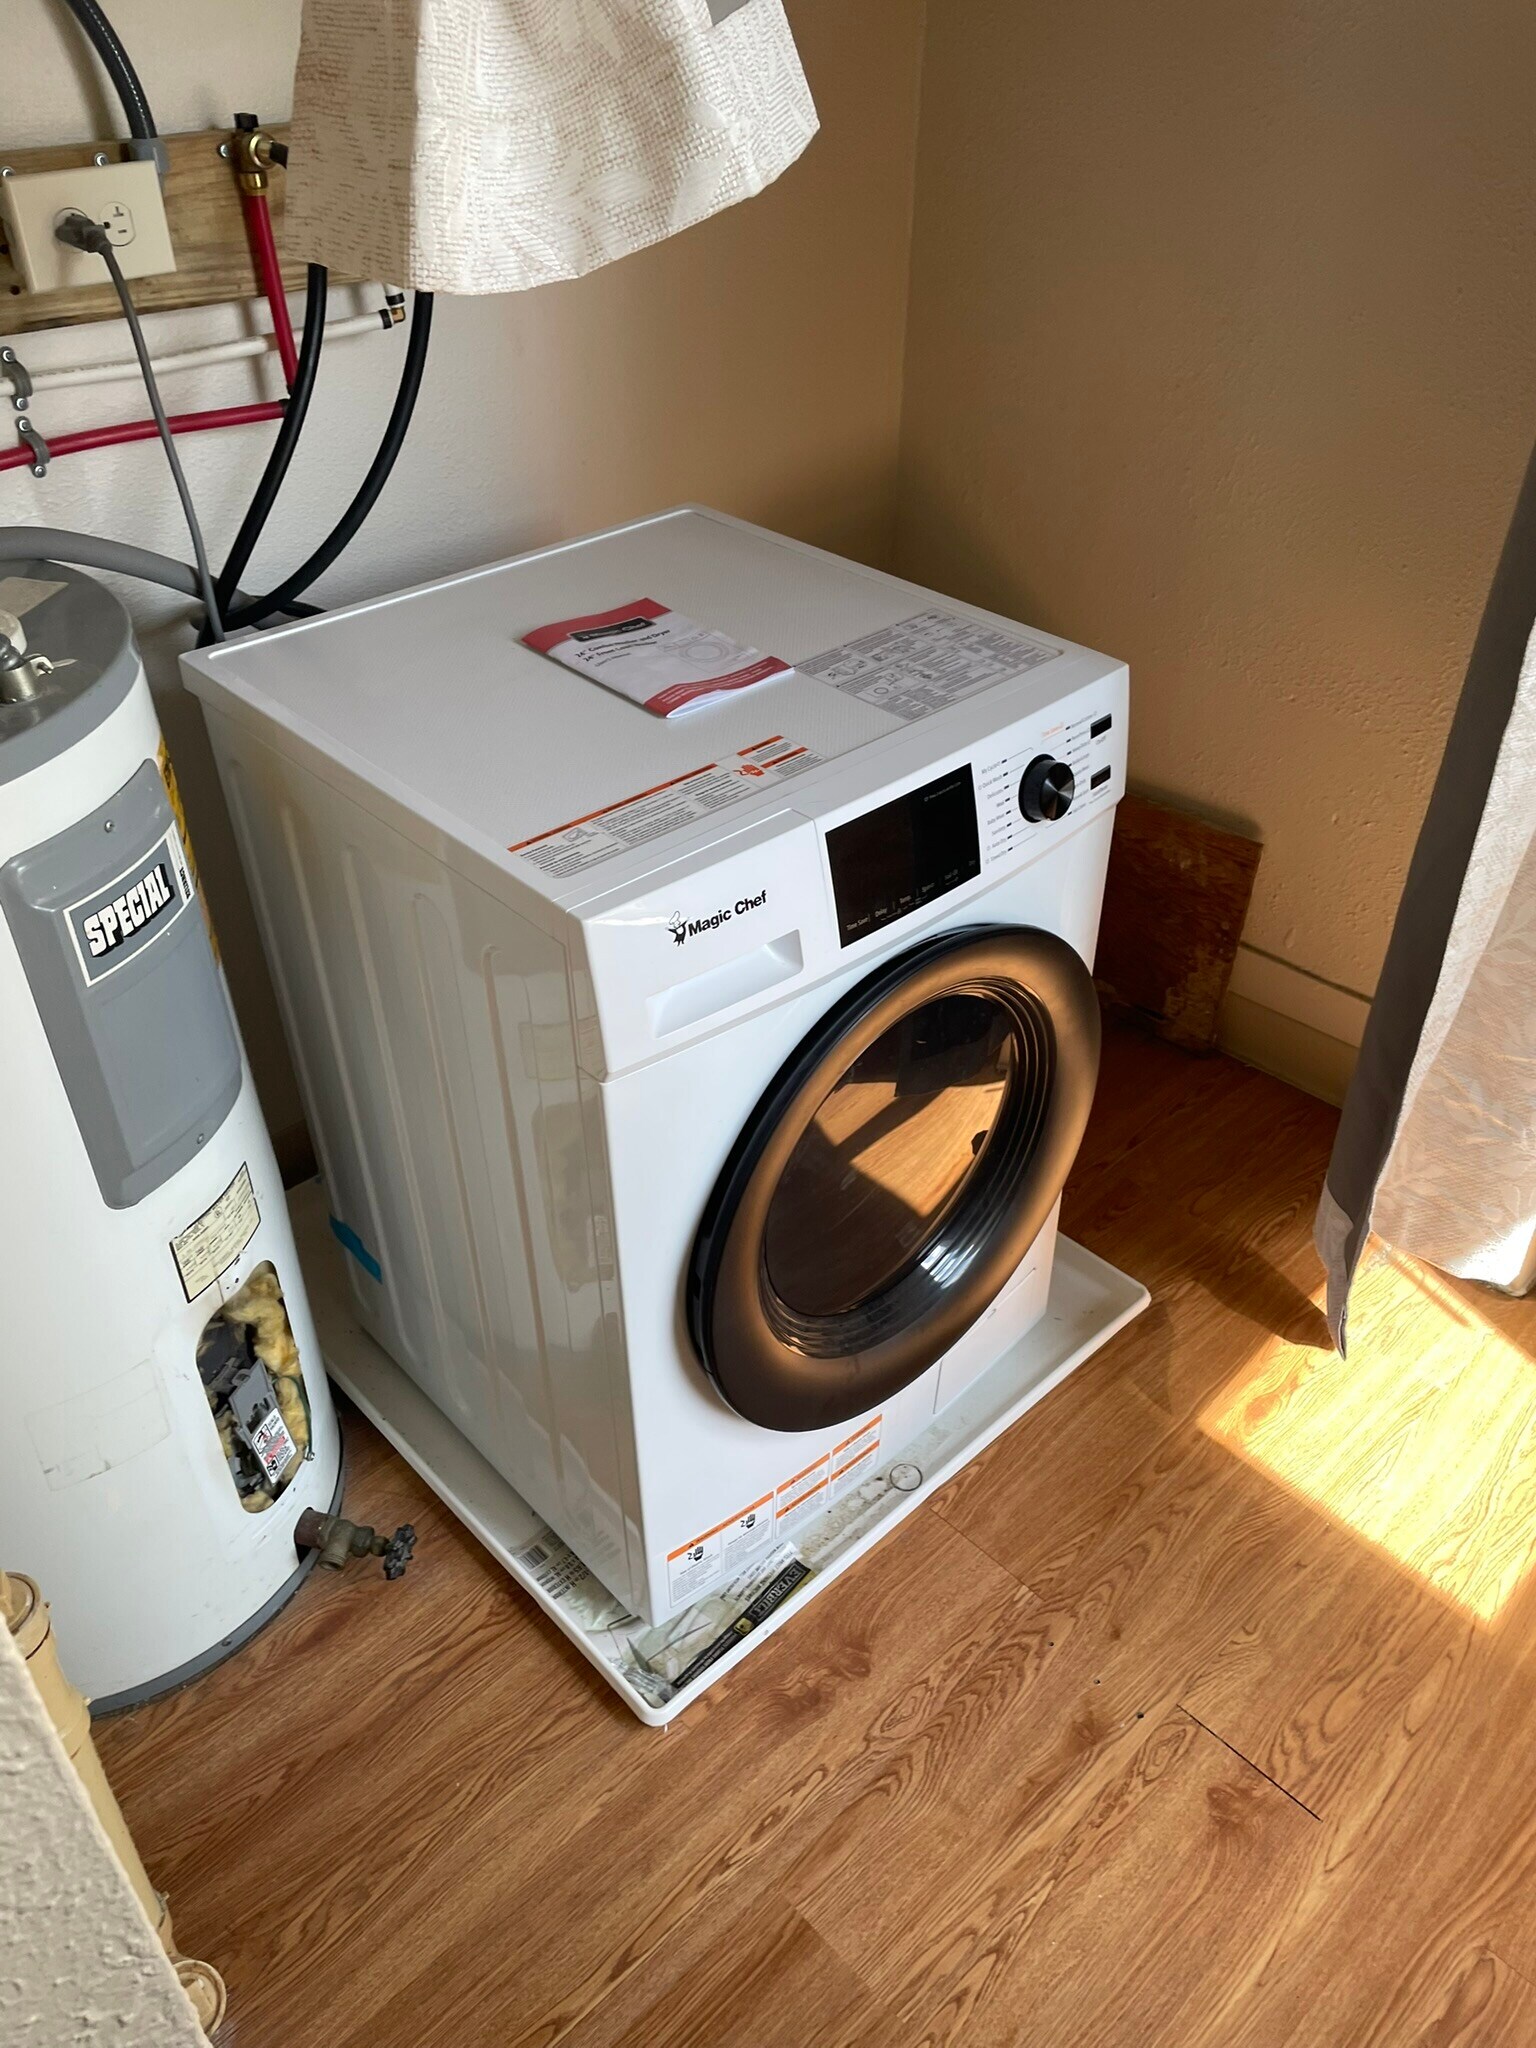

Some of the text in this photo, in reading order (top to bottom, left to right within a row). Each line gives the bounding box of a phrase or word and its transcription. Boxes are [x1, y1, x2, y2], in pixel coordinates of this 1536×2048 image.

[83, 863, 175, 958] SPECIAL
[688, 889, 768, 937] Magic Chef
[754, 1568, 801, 1617] EVERBILT
